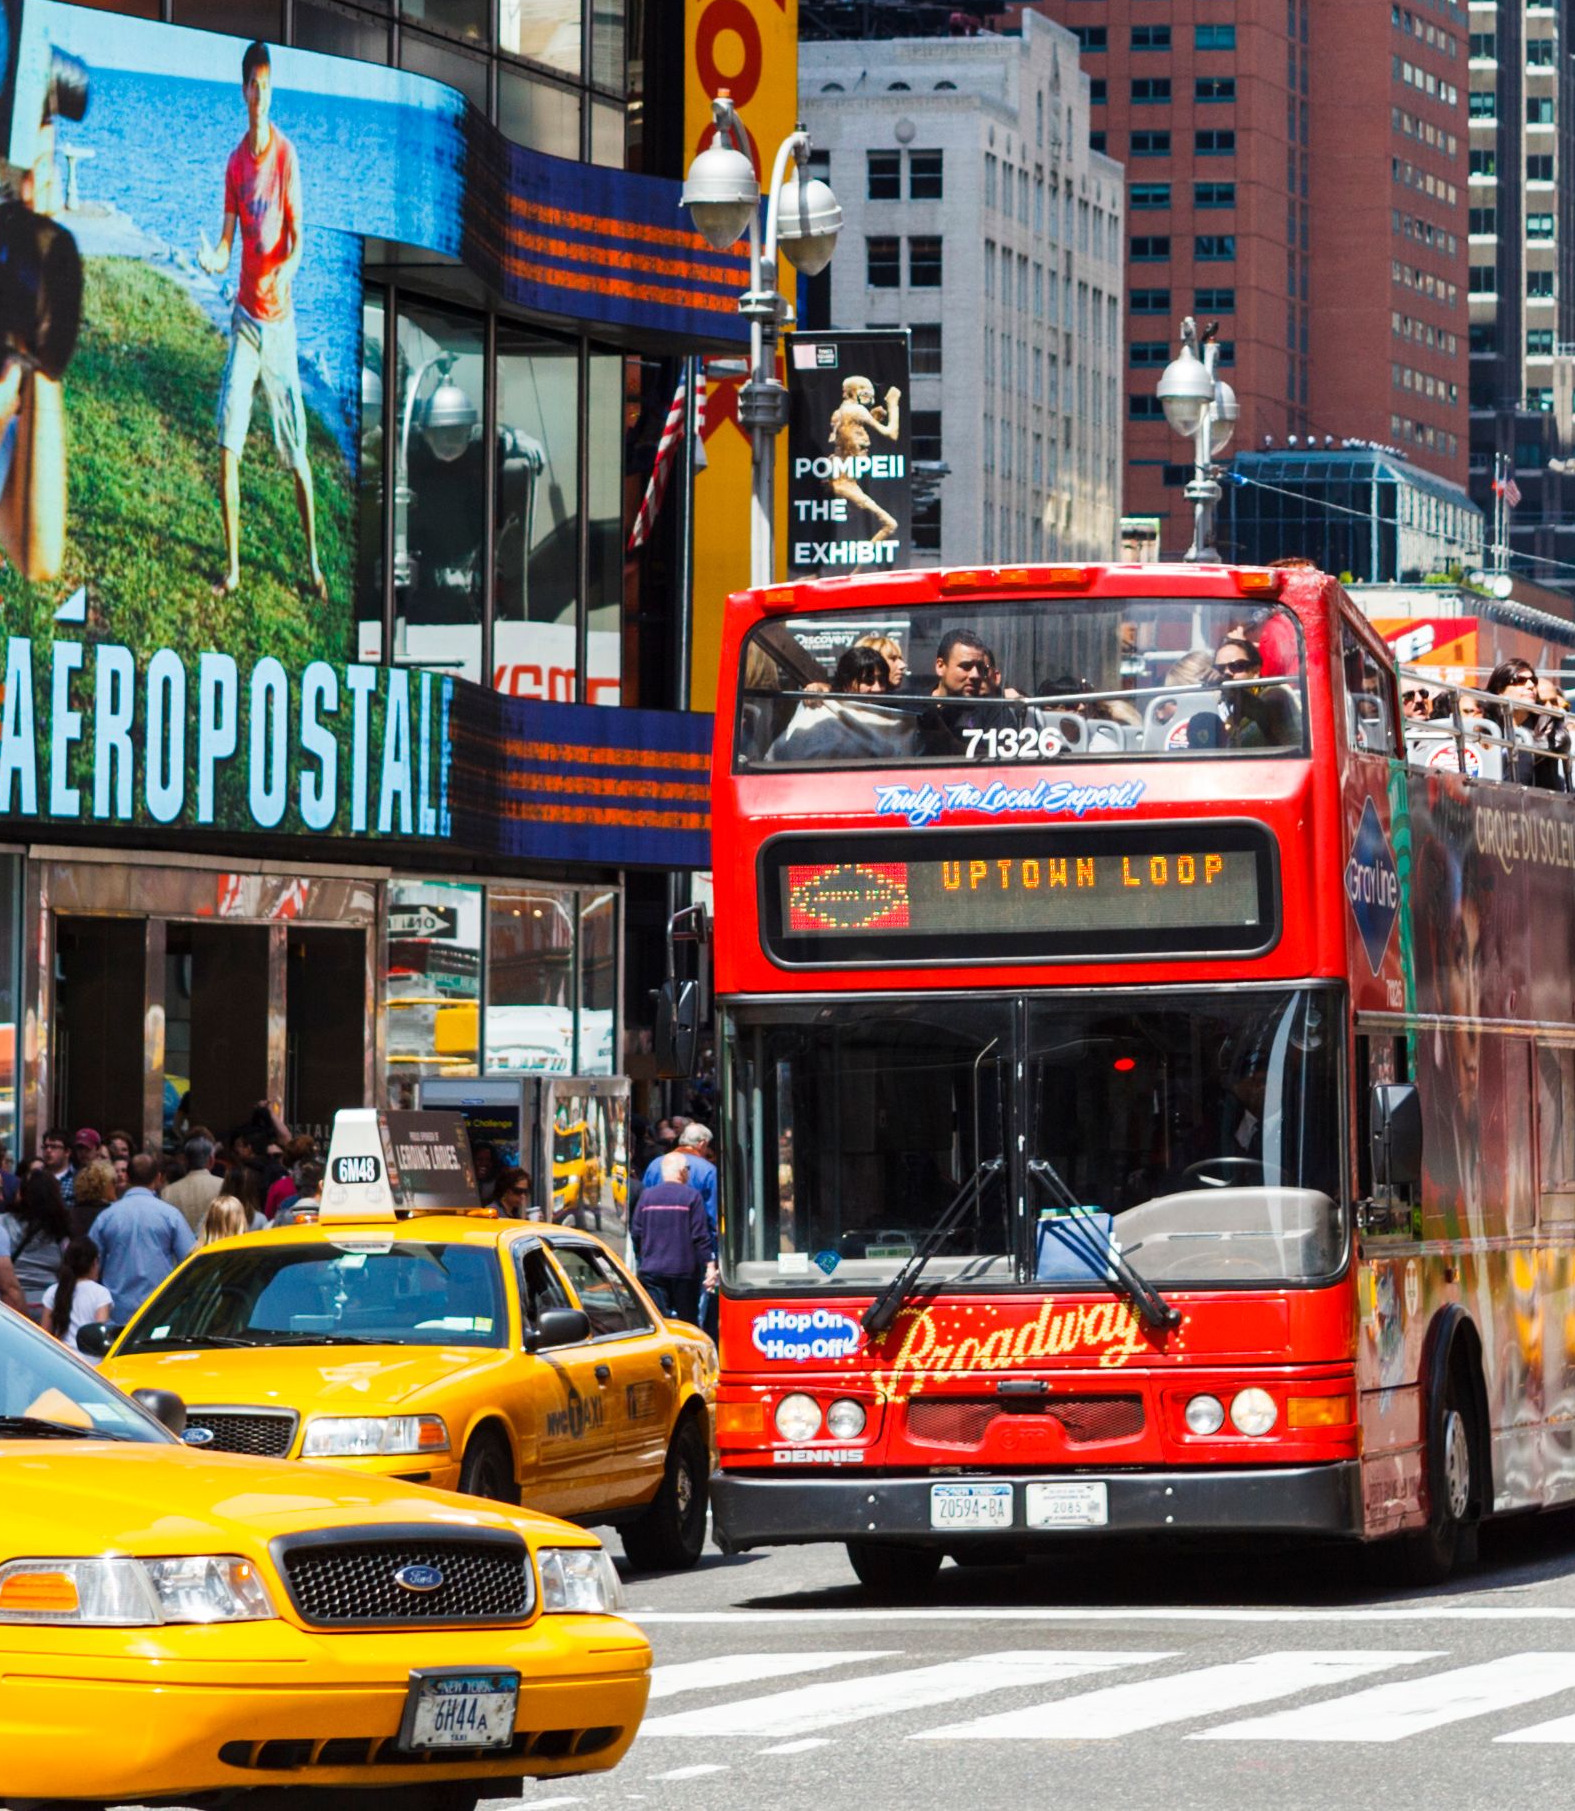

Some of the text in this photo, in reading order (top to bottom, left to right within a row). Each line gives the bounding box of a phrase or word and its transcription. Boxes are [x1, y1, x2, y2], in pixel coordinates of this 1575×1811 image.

[794, 454, 906, 480] POMPEII
[794, 497, 849, 523] THE
[794, 540, 901, 565] EXHIBIT
[962, 727, 1064, 760] 71326
[875, 779, 1146, 826] Truly, The Local Expert!
[1475, 803, 1520, 875] CIRQUE
[1520, 813, 1538, 860] DU
[942, 852, 1224, 890] UPTOWN LOOP
[337, 1156, 377, 1184] 6M48
[767, 1309, 844, 1334] Hop On
[767, 1337, 844, 1363] Hop Off
[872, 1297, 1149, 1406] Broadway
[773, 1449, 865, 1464] DENNIS
[406, 1568, 437, 1587] Ford
